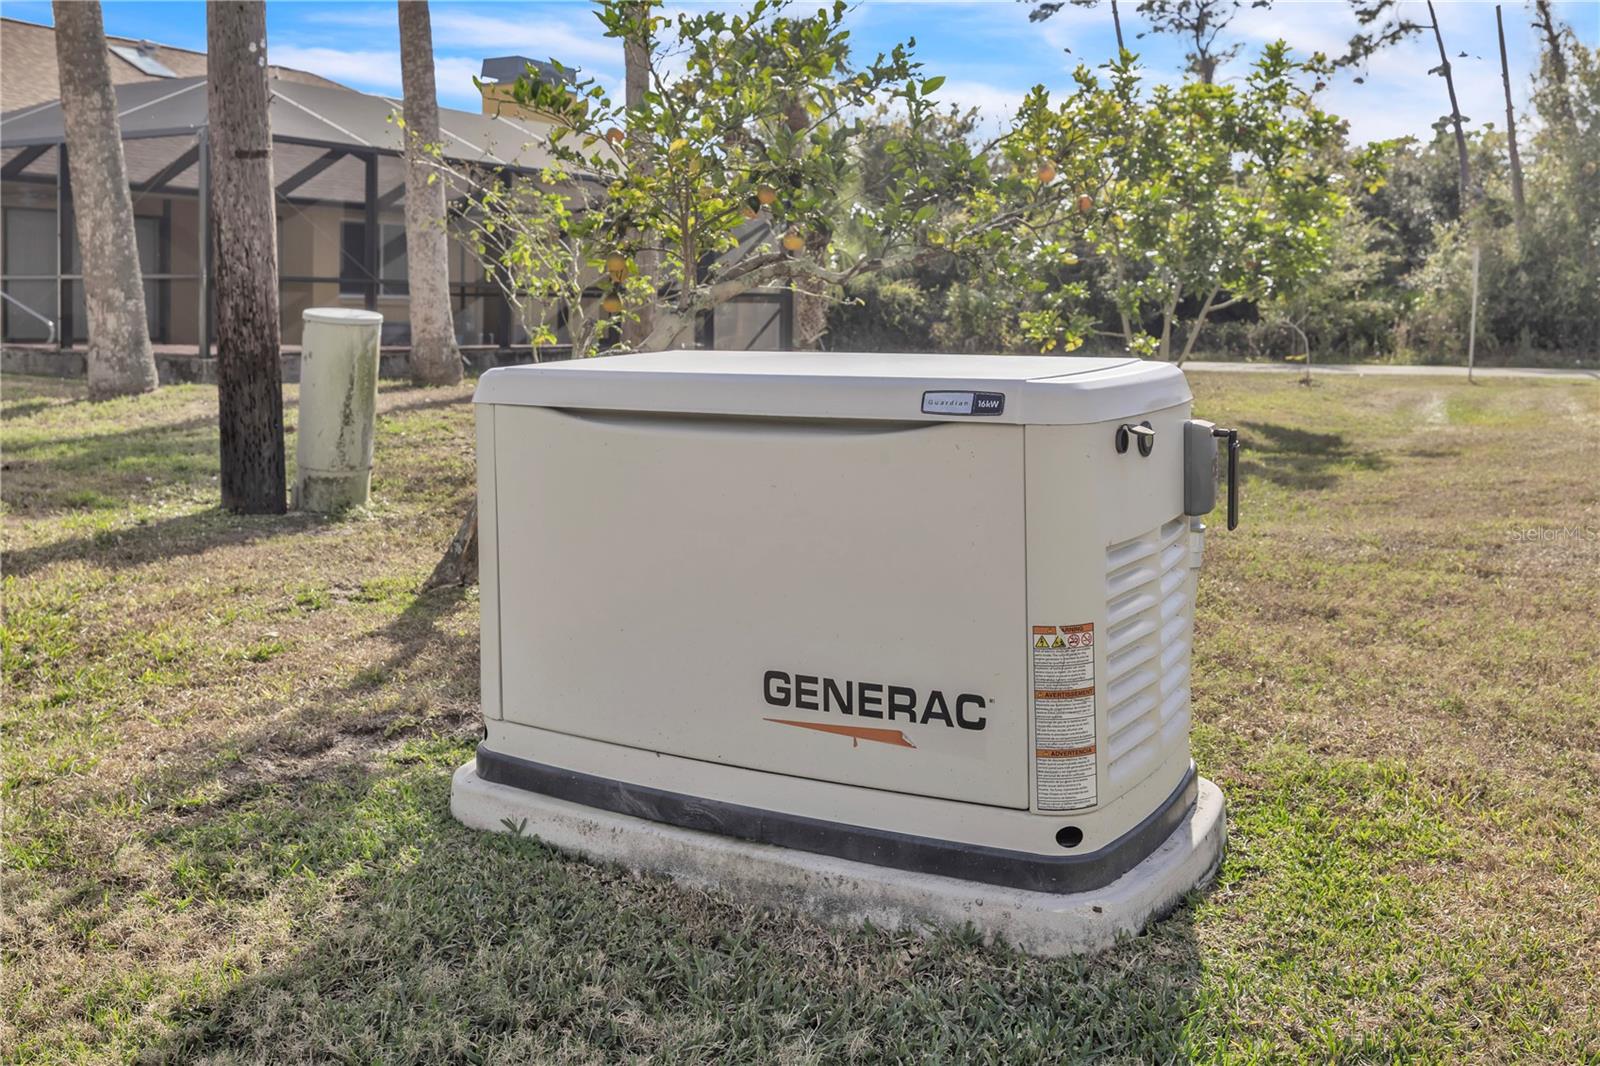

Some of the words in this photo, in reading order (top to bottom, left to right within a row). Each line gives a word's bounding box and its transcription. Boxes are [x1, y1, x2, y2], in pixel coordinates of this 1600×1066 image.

[928, 399, 970, 407] Guardian
[977, 400, 999, 409] 16kW
[1045, 689, 1093, 697] AVERTISSEMENT
[764, 670, 986, 731] GENERAC
[1050, 747, 1091, 756] ADVERTENCIA
